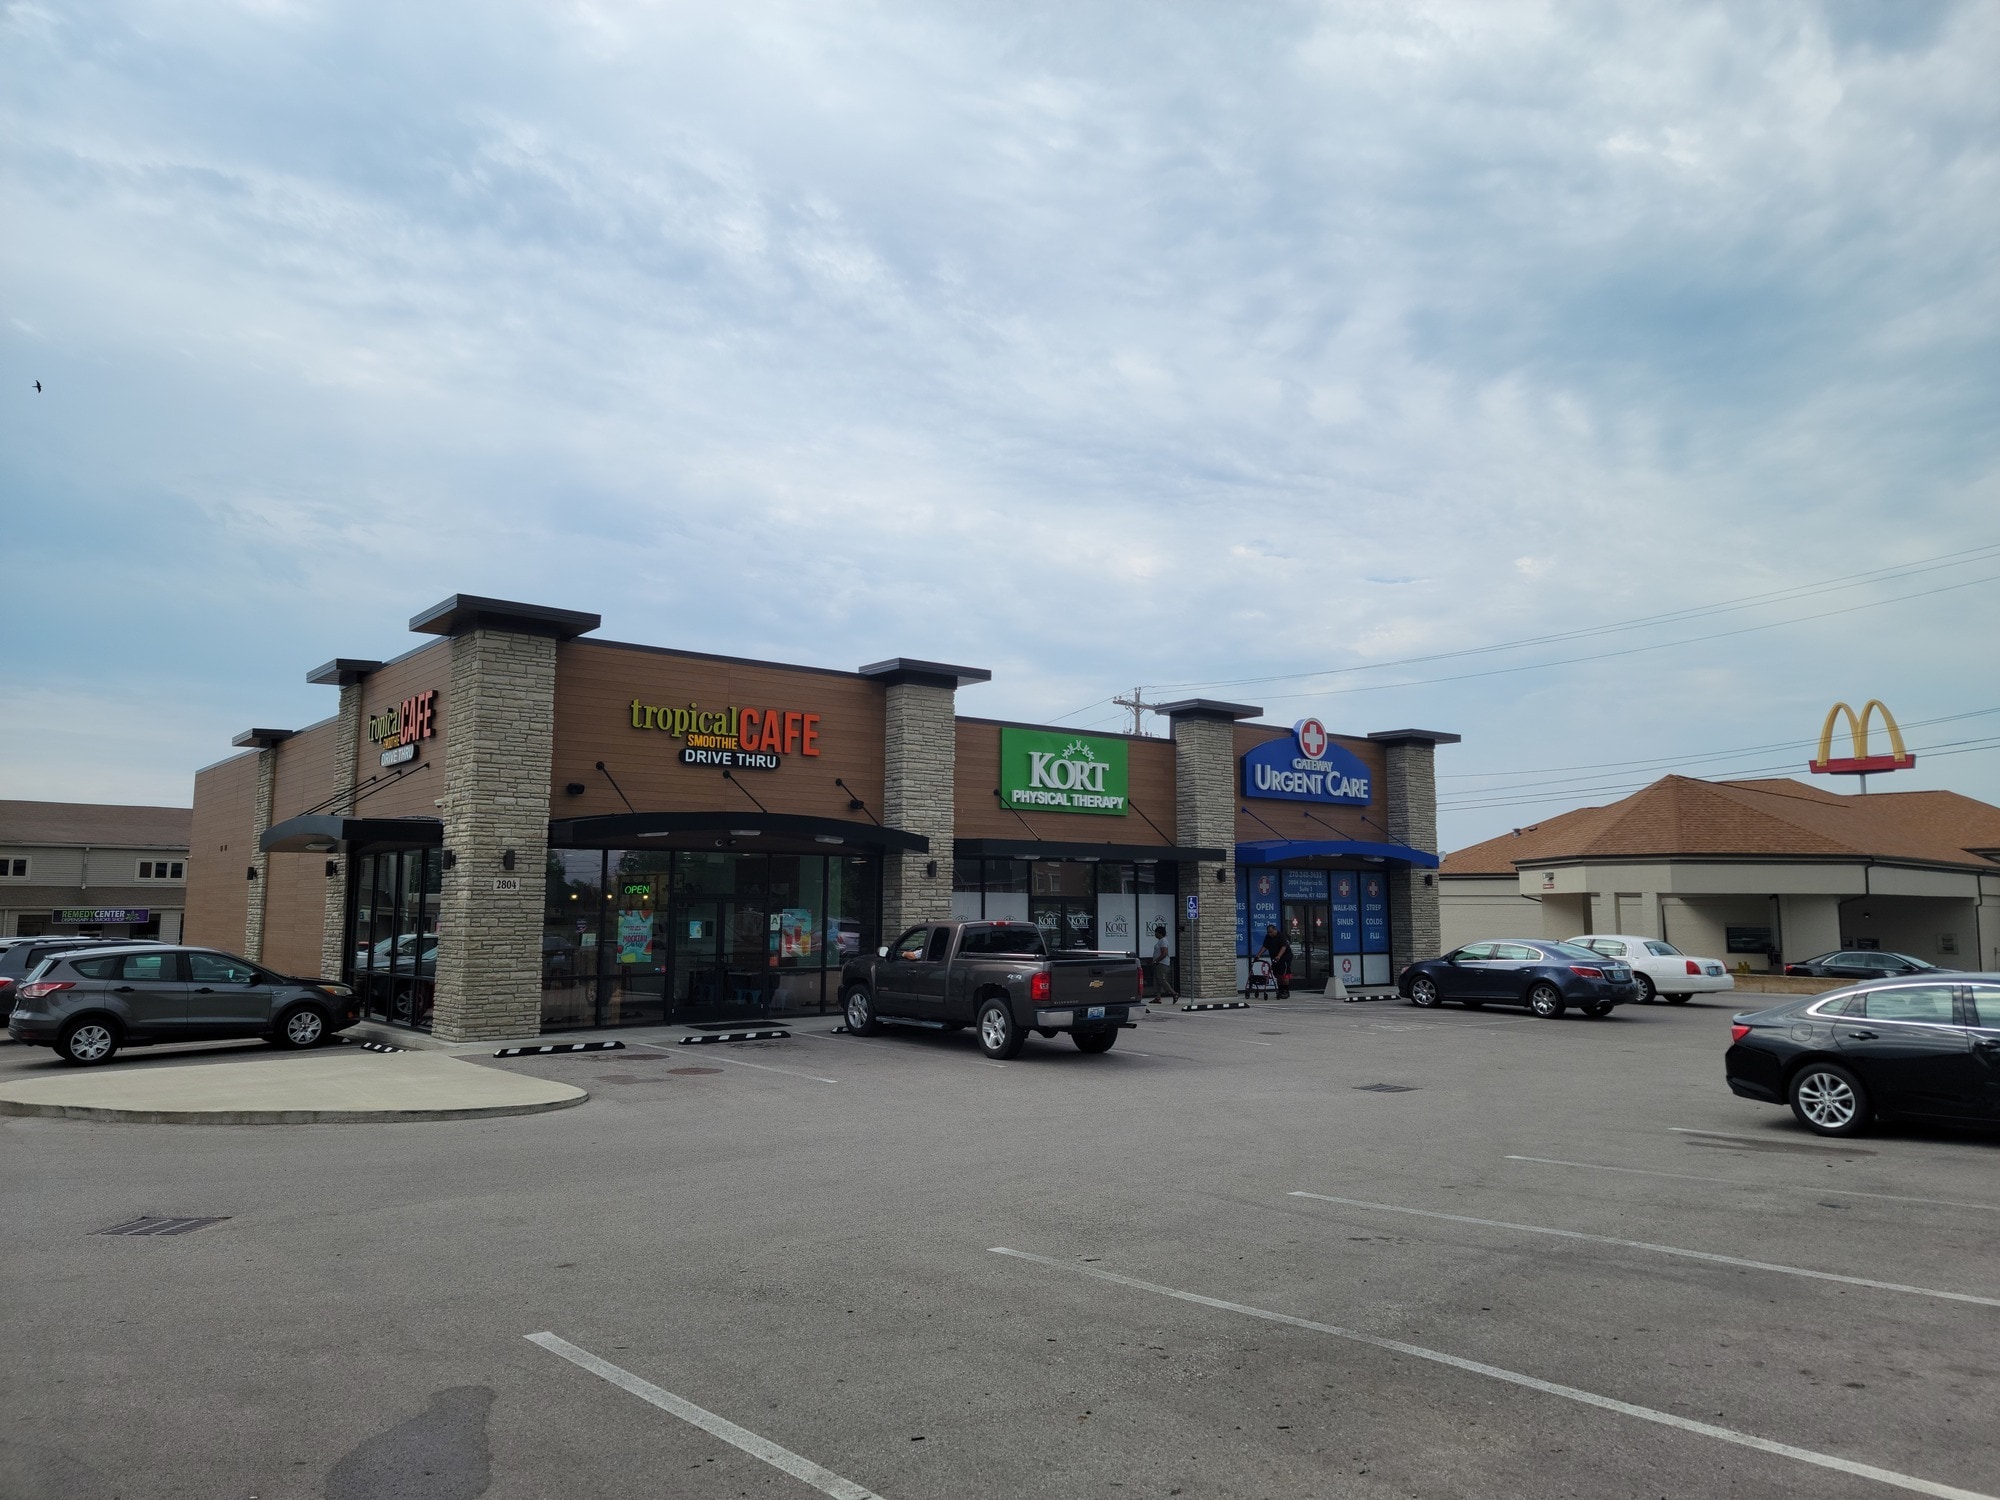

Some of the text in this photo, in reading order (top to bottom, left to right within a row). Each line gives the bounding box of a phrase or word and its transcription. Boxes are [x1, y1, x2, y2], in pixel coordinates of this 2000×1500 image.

[367, 690, 434, 745] tropical CAFE
[630, 698, 821, 757] tropical CAFE
[687, 734, 738, 750] SMOOTHIE
[381, 750, 398, 766] DRIVE
[685, 749, 776, 768] DRIVE THRU
[1292, 758, 1333, 773] GATEWAY
[1028, 751, 1110, 792] KORT
[1255, 764, 1369, 799] URGENT CARE
[1011, 790, 1124, 809] PHYSICAL THERAPY
[496, 880, 516, 889] 2804
[625, 885, 650, 894] OPEN
[1038, 916, 1057, 925] KORT
[1071, 917, 1090, 926] KORT
[1105, 922, 1128, 933] KORT
